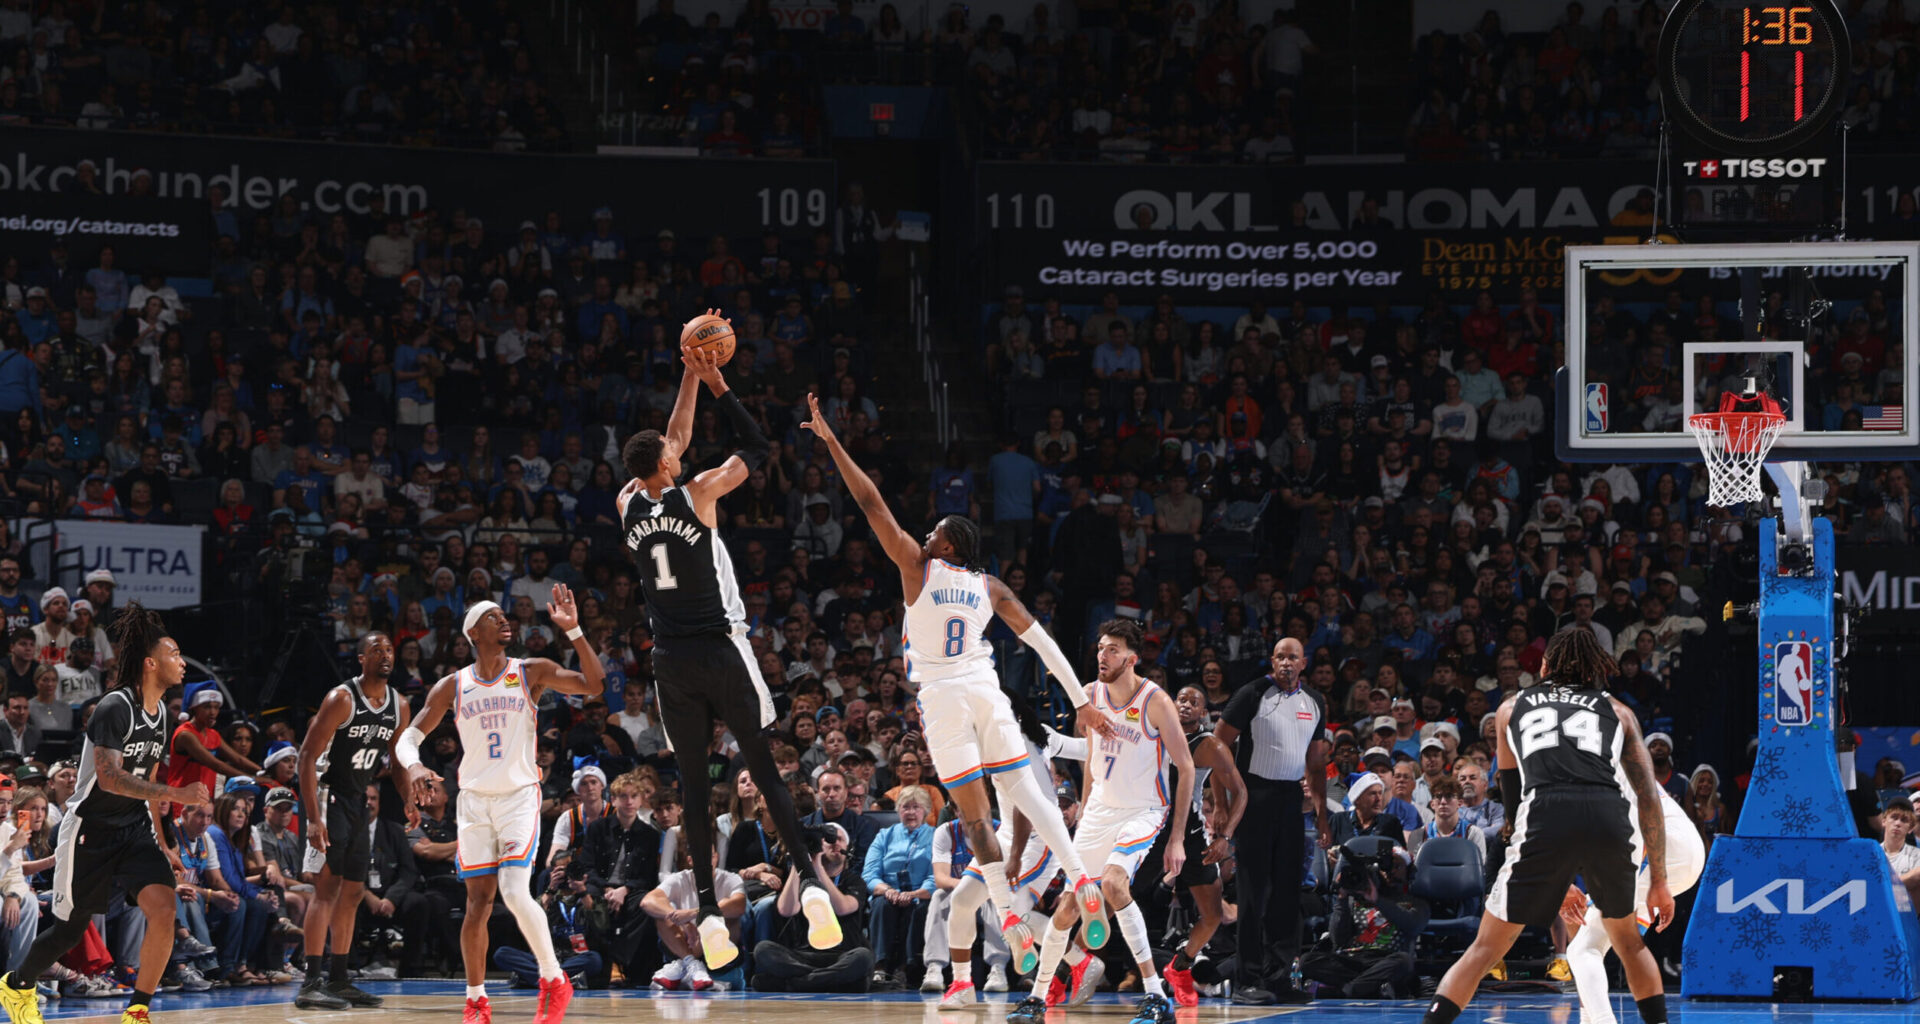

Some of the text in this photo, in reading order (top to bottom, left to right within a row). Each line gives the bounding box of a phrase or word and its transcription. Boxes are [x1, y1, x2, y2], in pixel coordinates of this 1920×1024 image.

[1742, 7, 1813, 45] 1:36
[1740, 50, 1805, 122] 11
[1721, 158, 1827, 178] TISSOT
[756, 188, 827, 227] 109
[986, 193, 1056, 229] 110
[1063, 239, 1379, 262] We Perform Over 5,000
[1422, 236, 1580, 262] Dean McG
[1039, 267, 1403, 291] Cataract Surgeries per Year
[1421, 262, 1564, 276] EYE INSTITU
[1737, 265, 1785, 279] ur
[1811, 264, 1893, 281] riority
[1438, 276, 1493, 289] 1975
[1520, 275, 1563, 289] 202
[626, 516, 703, 552] WEMBANYAMA
[650, 542, 678, 591] 1
[930, 588, 981, 610] WILLIAMS
[942, 615, 968, 658] 8
[461, 695, 526, 720] OKLAHOMA
[1525, 692, 1599, 711] VASSELL
[1780, 706, 1799, 720] NBA
[480, 713, 508, 730] CITY
[1518, 706, 1603, 760] 24
[487, 731, 504, 760] 2
[1100, 738, 1123, 754] CITY
[1112, 724, 1142, 745] HOMA
[351, 748, 380, 770] 40
[1104, 755, 1117, 780] 7
[1716, 878, 1867, 915] KIA
